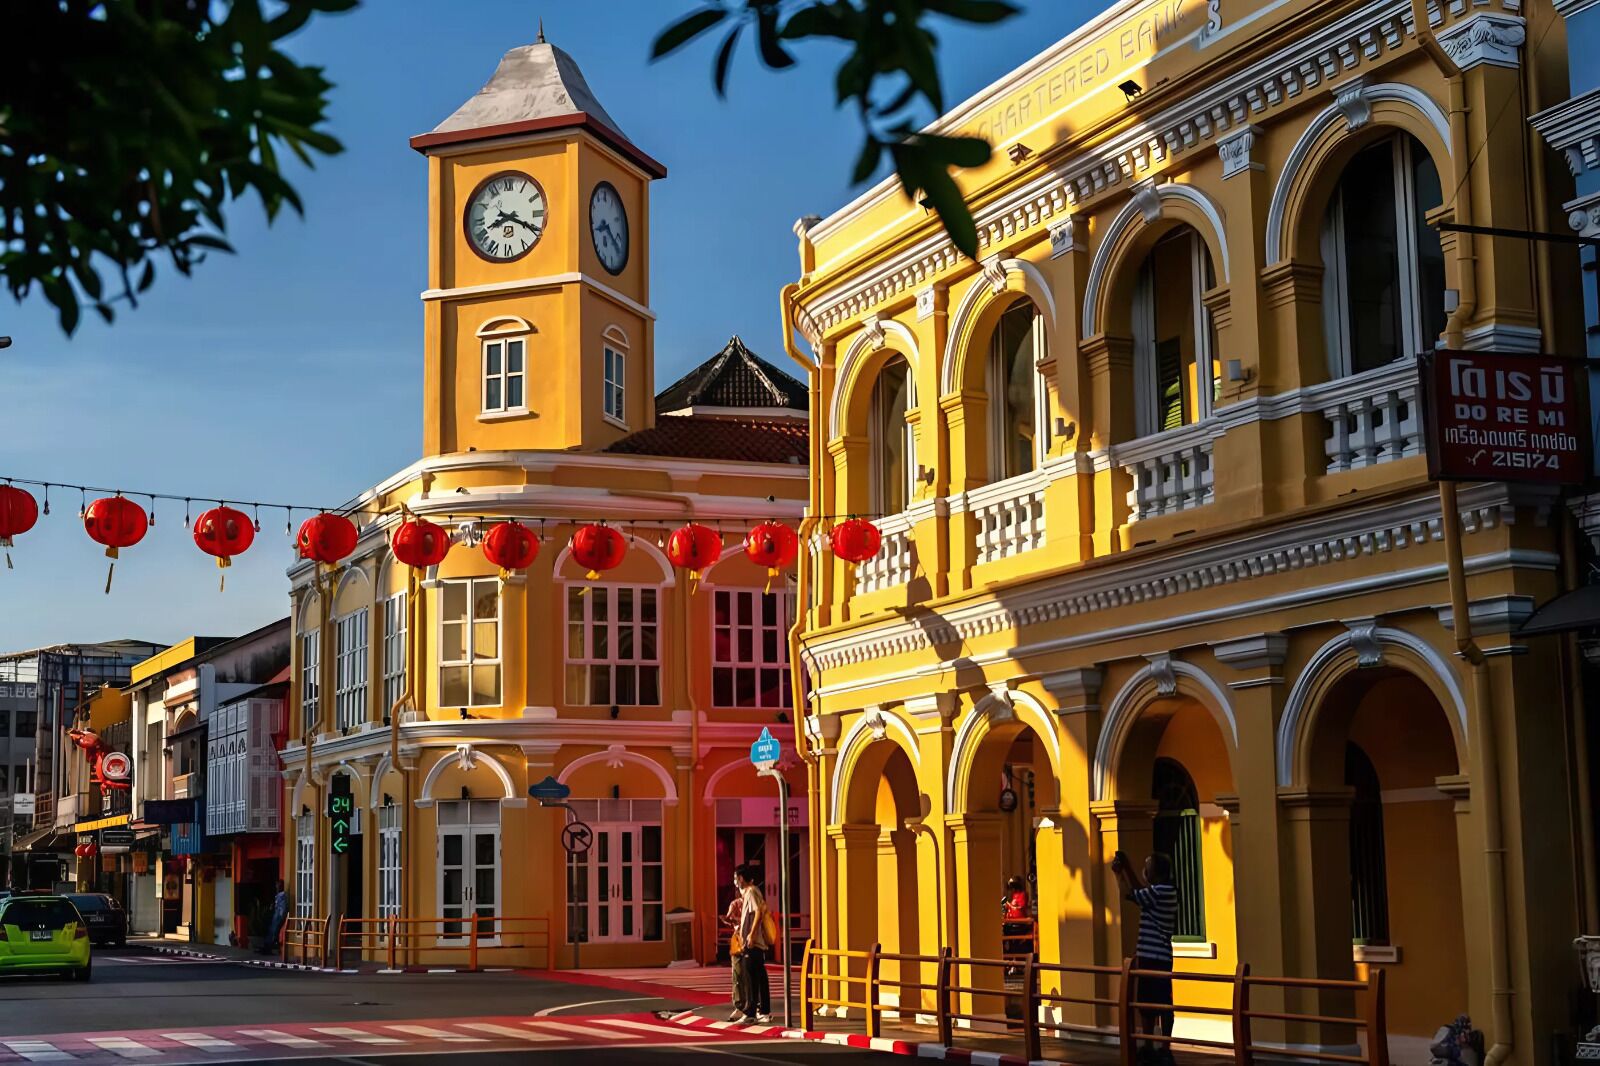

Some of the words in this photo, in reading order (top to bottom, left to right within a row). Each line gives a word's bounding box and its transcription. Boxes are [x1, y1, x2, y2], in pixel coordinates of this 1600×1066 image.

[1495, 369, 1532, 401] เร
[1454, 403, 1487, 421] DO
[1496, 405, 1529, 424] RE
[1537, 409, 1566, 427] MI
[1491, 450, 1560, 470] 215174
[332, 797, 350, 813] 24
